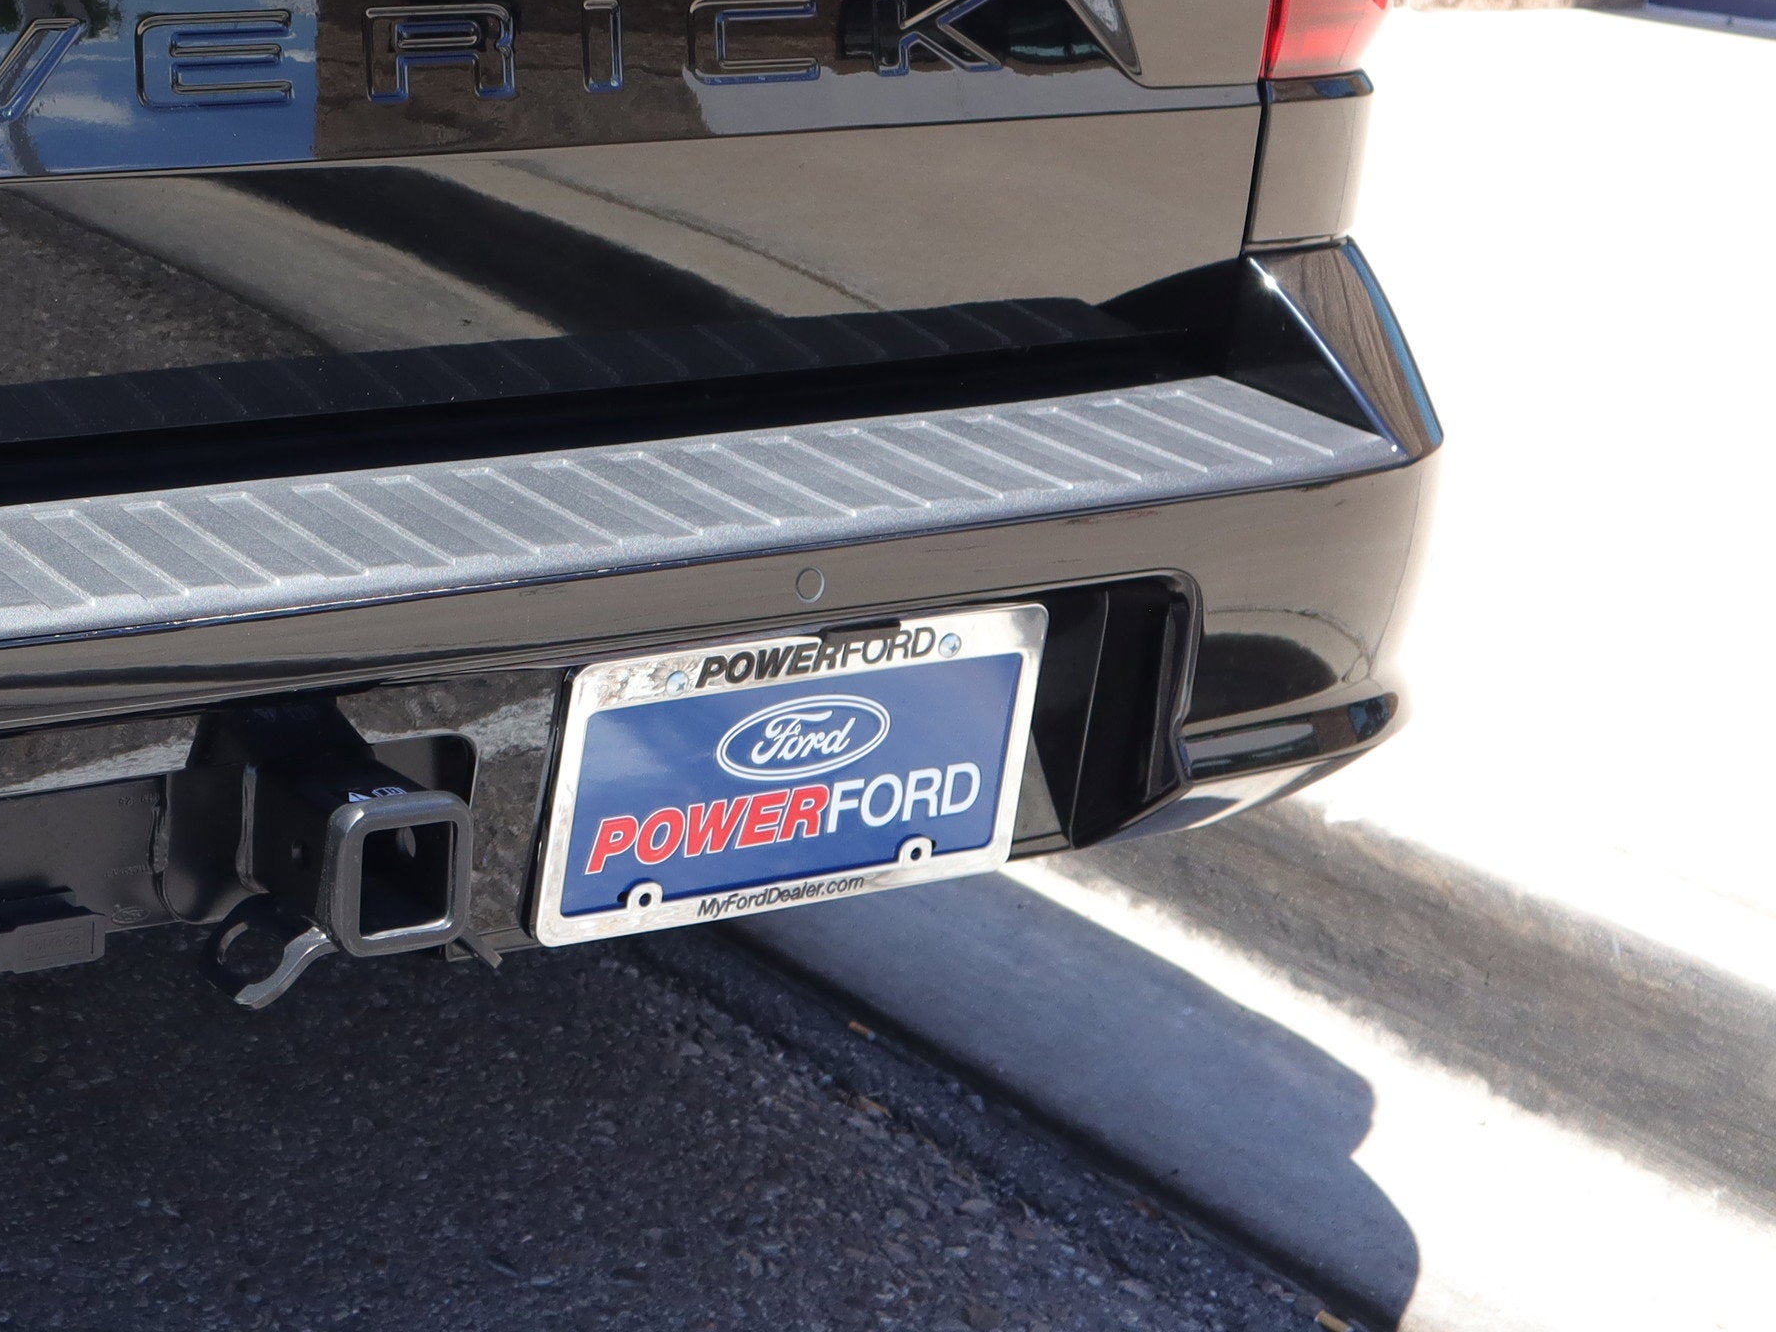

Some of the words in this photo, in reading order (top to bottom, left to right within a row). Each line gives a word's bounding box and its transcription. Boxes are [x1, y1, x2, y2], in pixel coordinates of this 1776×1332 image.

[695, 627, 935, 687] POWERFORD
[750, 710, 857, 764] Ford
[585, 762, 982, 874] POWERFORD
[696, 875, 865, 919] MyFordDealer.com
